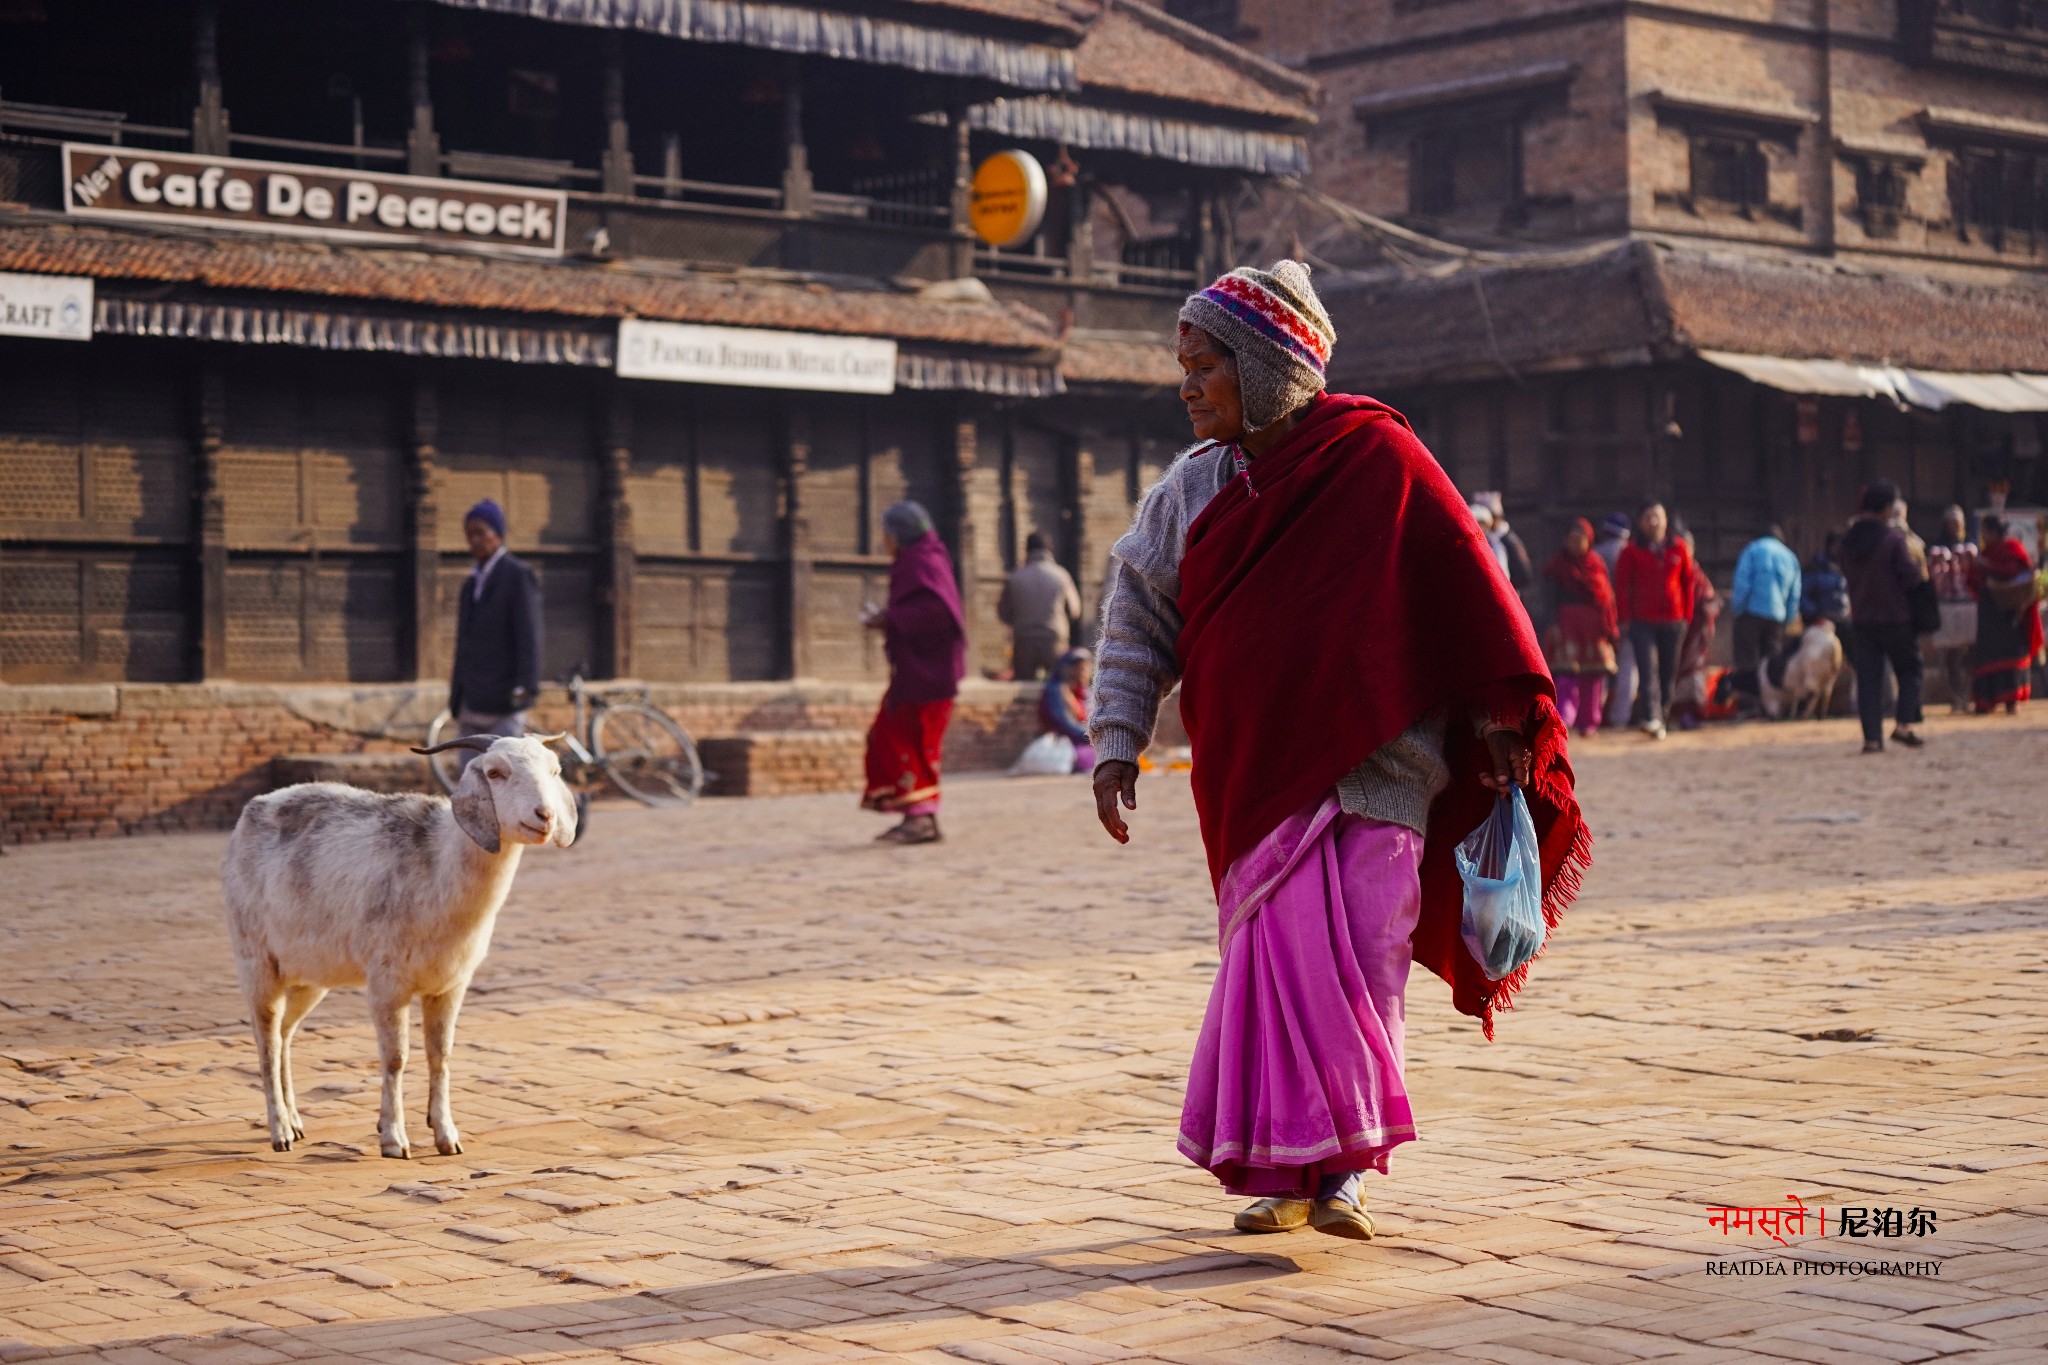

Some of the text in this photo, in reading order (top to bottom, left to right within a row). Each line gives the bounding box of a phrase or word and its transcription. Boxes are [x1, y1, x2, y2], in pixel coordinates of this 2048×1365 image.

[73, 153, 553, 240] New Cafe De Peacock
